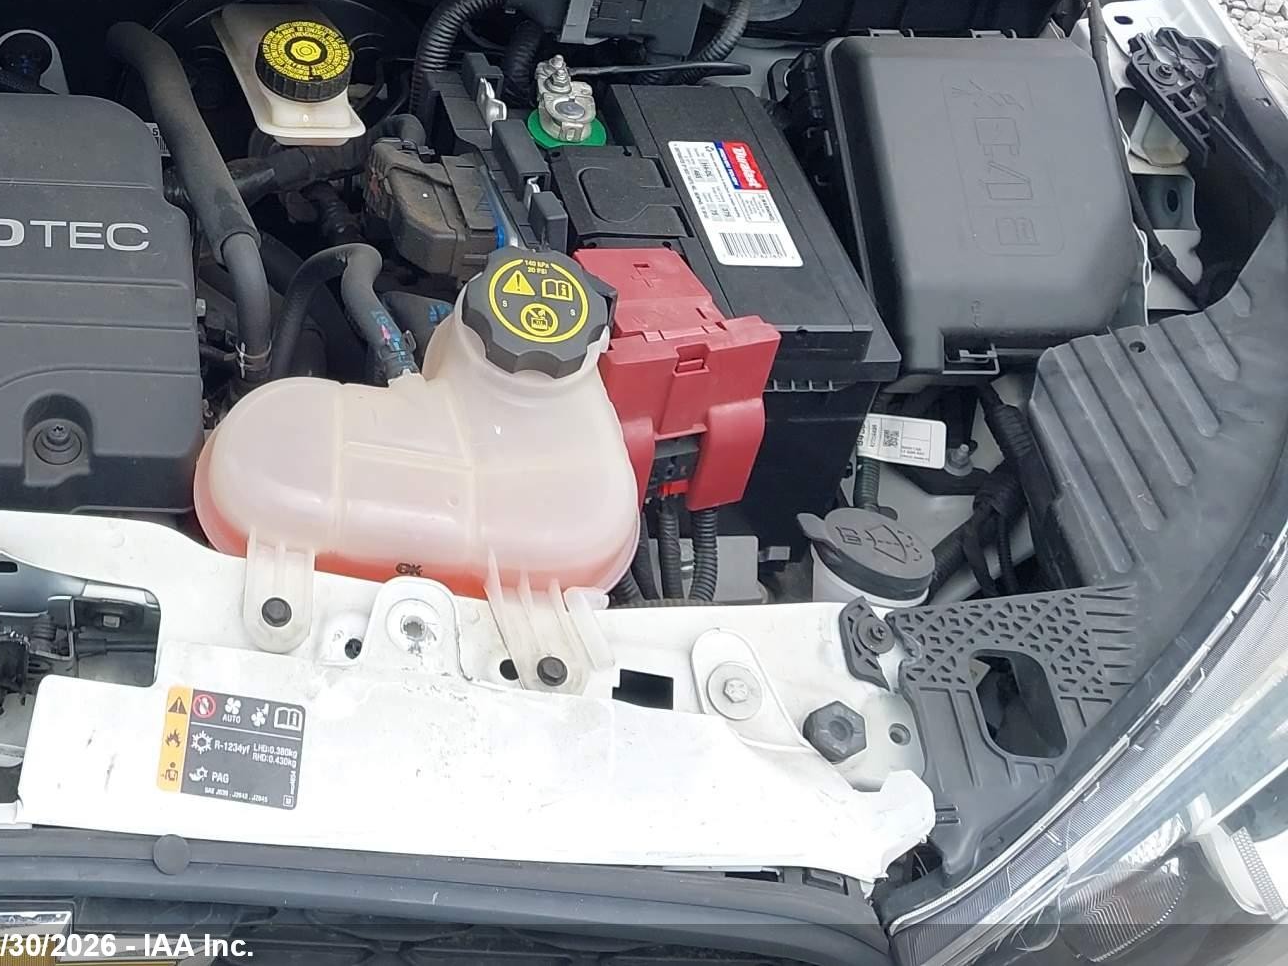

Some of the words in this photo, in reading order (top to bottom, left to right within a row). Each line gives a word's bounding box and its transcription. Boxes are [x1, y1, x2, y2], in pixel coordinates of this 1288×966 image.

[222, 714, 241, 724] AUTO
[214, 740, 251, 755] R-1234yf
[211, 771, 229, 784] PAG
